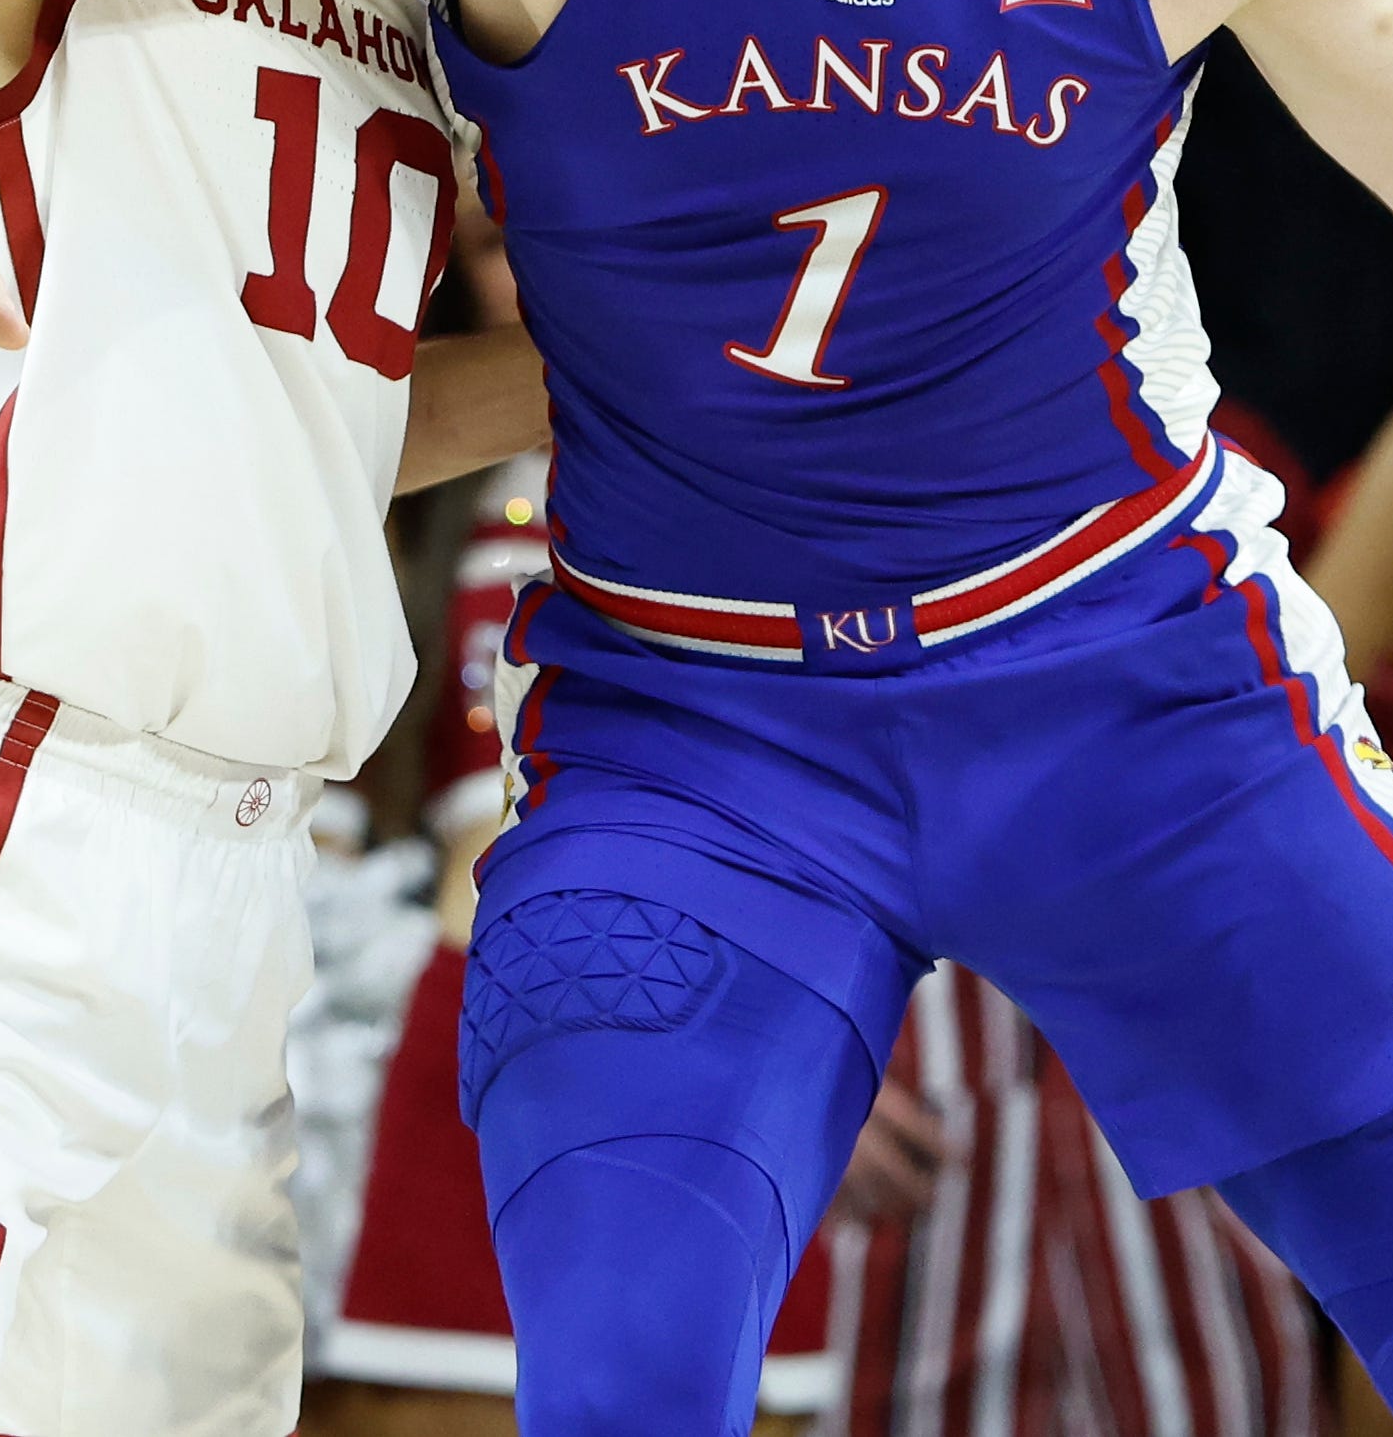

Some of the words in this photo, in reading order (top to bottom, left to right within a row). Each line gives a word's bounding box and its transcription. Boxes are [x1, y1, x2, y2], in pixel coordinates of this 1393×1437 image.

[617, 35, 1090, 148] KANSAS
[241, 66, 457, 381] 10
[724, 184, 888, 390] 1
[816, 606, 898, 653] KU
